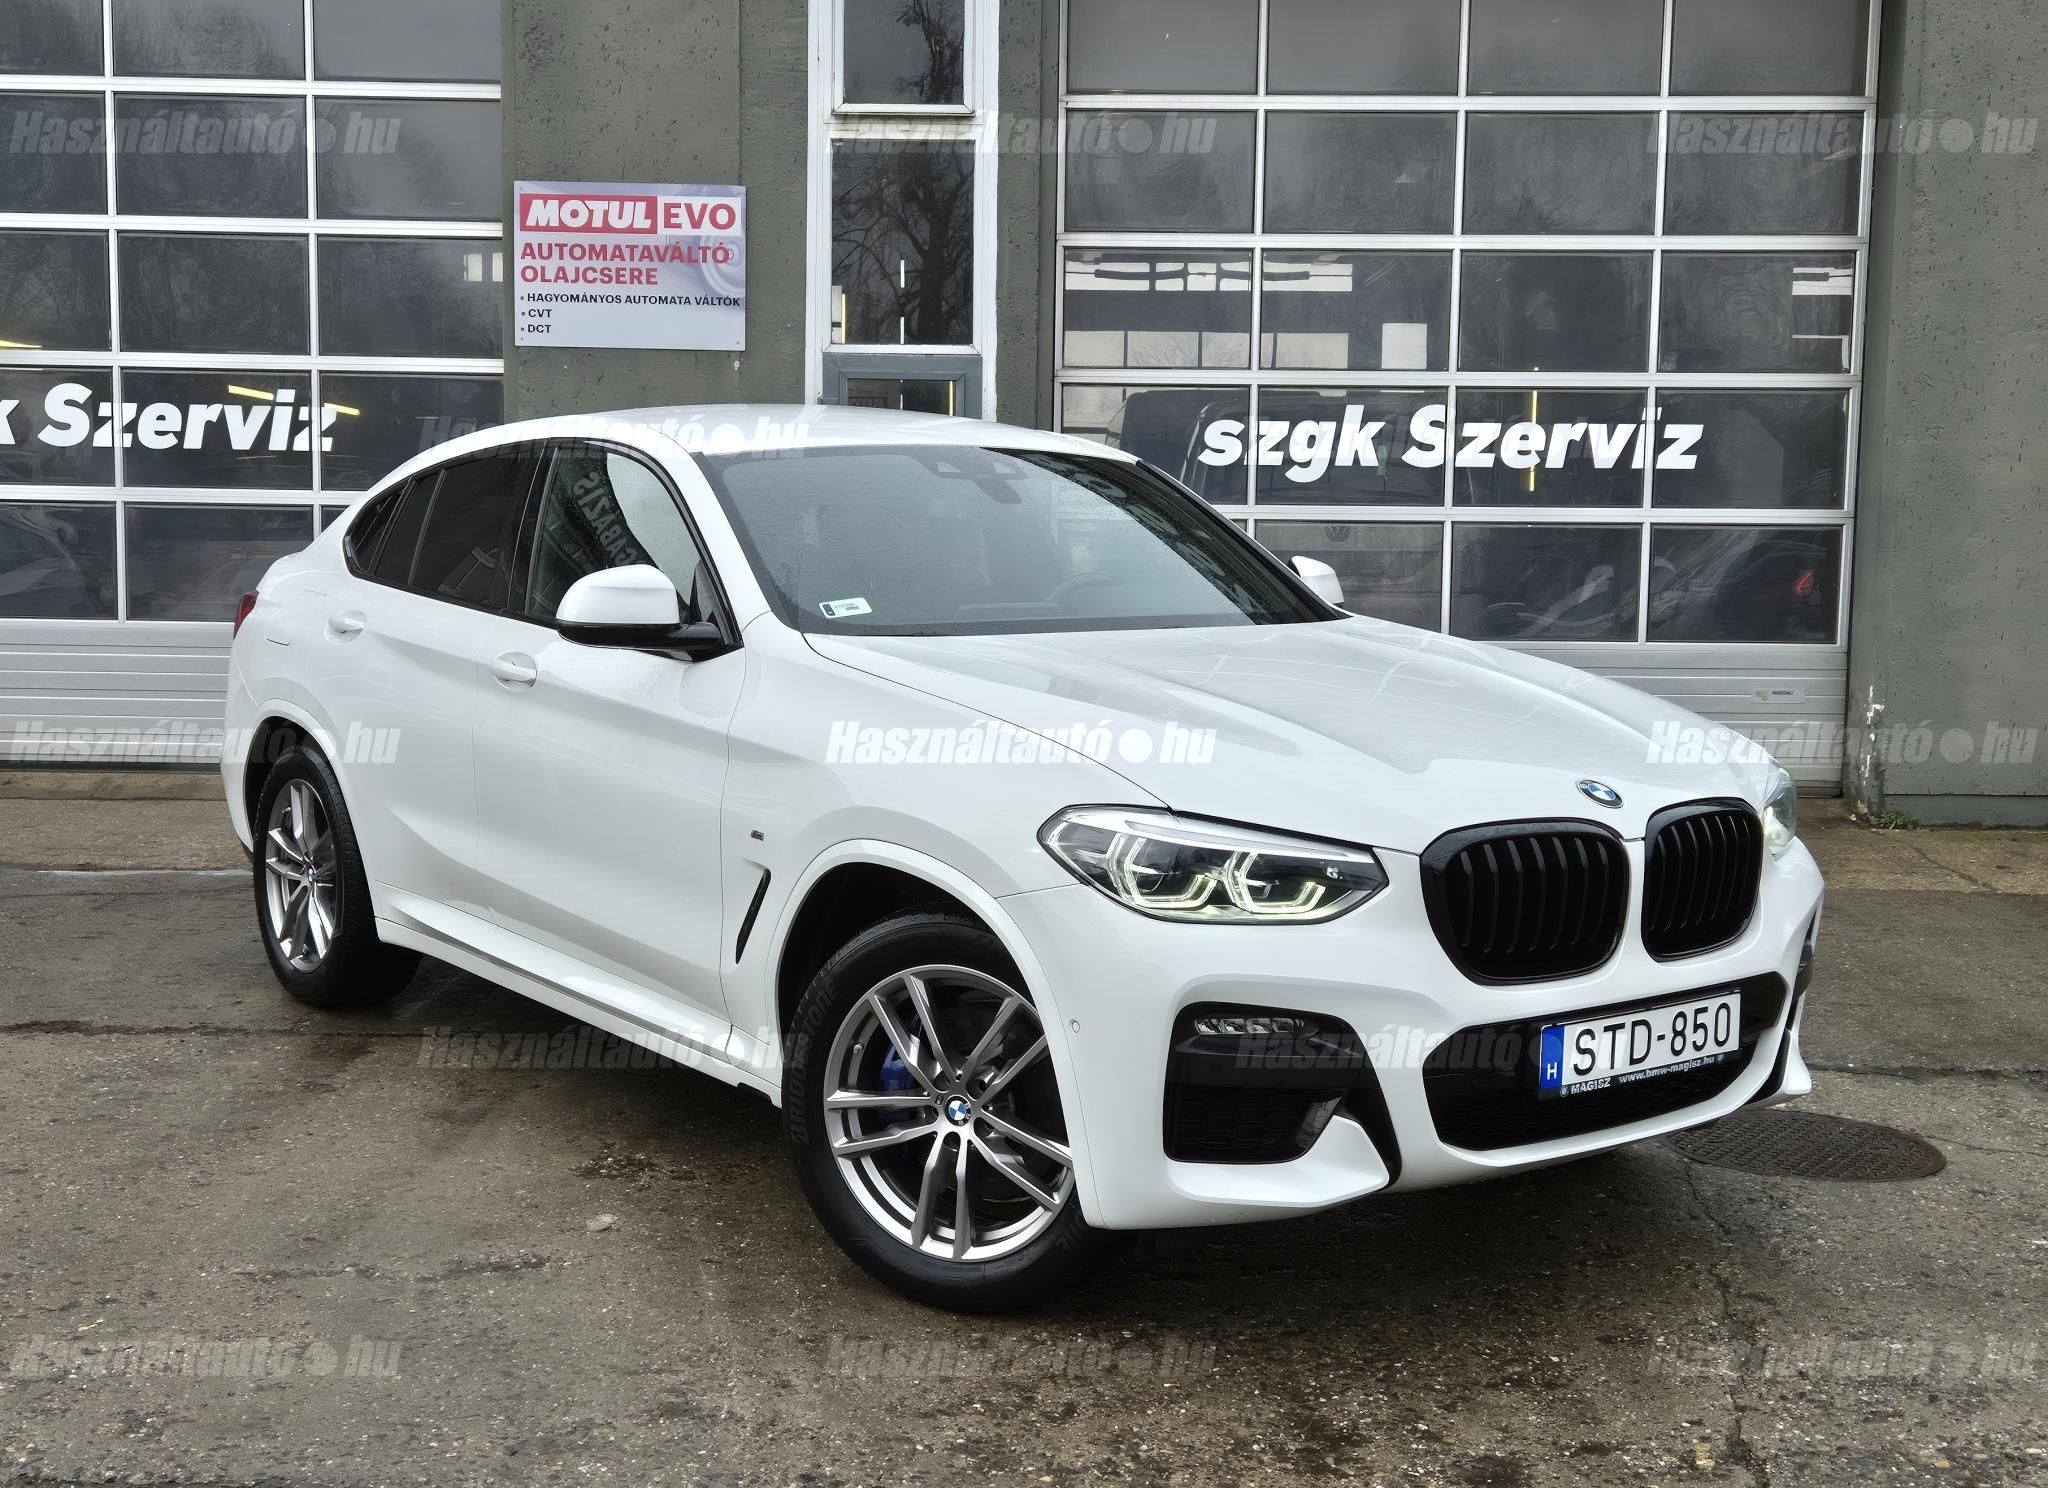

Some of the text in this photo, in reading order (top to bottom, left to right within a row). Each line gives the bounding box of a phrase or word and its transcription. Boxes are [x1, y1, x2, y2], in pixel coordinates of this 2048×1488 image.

[526, 199, 736, 230] MOTUL EVO
[520, 241, 730, 265] AUTOMATAVÁLTÓ
[520, 265, 658, 285] OLAJCSERE
[527, 293, 740, 307] HAGYOMÁNYOS AUTOMATA VÁLTÓK
[528, 309, 552, 318] CVT
[527, 324, 551, 334] DCT
[37, 382, 337, 452] Szerviz
[1198, 404, 1386, 483] szgk
[1401, 403, 1704, 470] Szerviz
[1573, 1002, 1731, 1076] STD-850
[1547, 1062, 1558, 1080] H
[1571, 1056, 1715, 1095] MAGISZ www.bmw-magisz.hu
